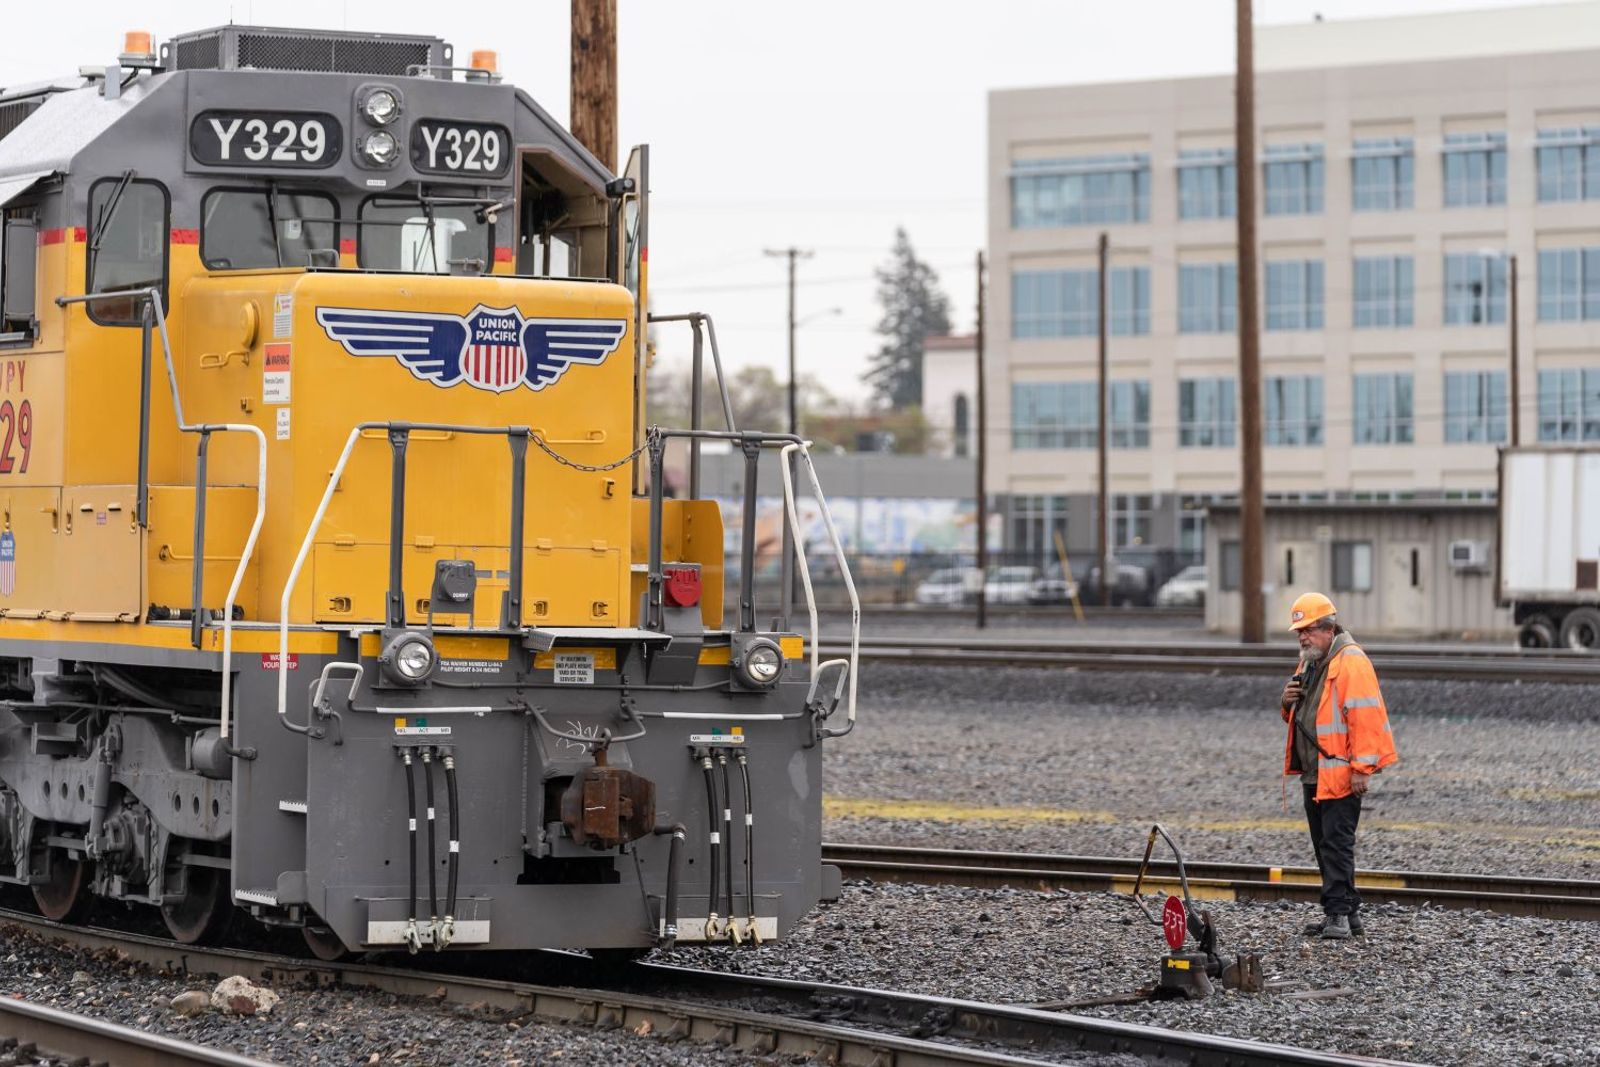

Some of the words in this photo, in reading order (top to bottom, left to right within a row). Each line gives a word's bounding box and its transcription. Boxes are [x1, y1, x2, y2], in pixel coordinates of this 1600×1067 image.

[208, 118, 326, 162] Y329
[421, 126, 500, 171] Y329
[479, 318, 516, 329] UNION
[476, 330, 517, 342] PACIFIC
[262, 661, 280, 669] YOUR
[1164, 908, 1184, 935] 537
